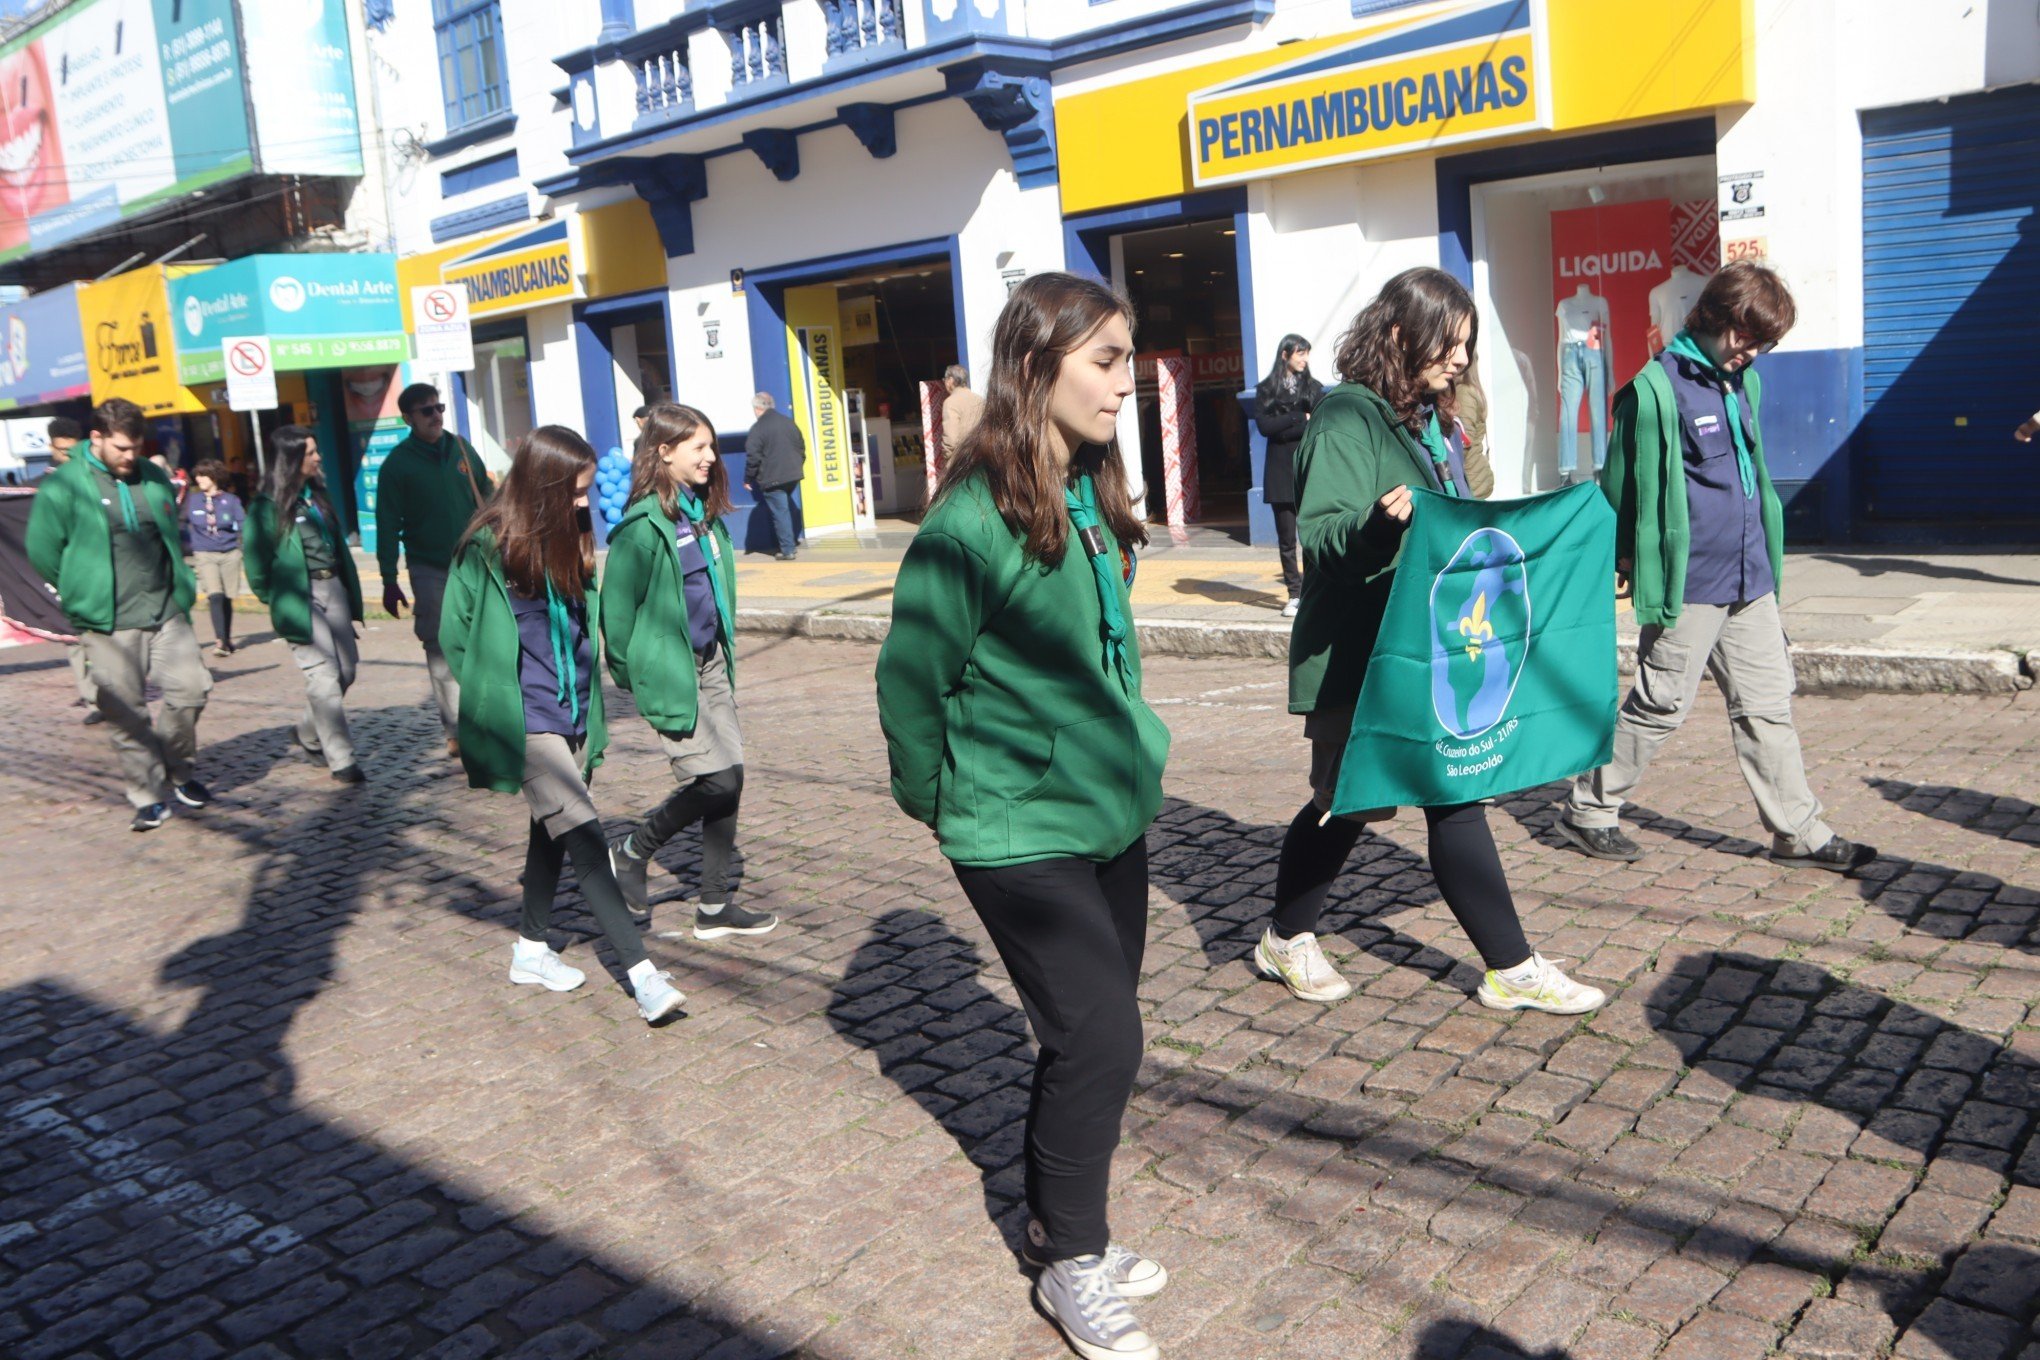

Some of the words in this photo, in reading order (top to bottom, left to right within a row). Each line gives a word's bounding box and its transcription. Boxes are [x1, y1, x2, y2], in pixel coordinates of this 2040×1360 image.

[1199, 55, 1528, 163] PERNAMBUCANAS
[1560, 250, 1663, 277] LIQUIDA
[307, 279, 359, 297] Dental
[362, 279, 395, 296] Arte
[813, 333, 839, 483] PERNAMBUCANAS
[1443, 744, 1467, 758] Cruzeiro
[1468, 744, 1480, 756] do
[1480, 736, 1494, 752] Sul
[1446, 763, 1459, 777] São
[1458, 754, 1504, 776] Leopoldo
